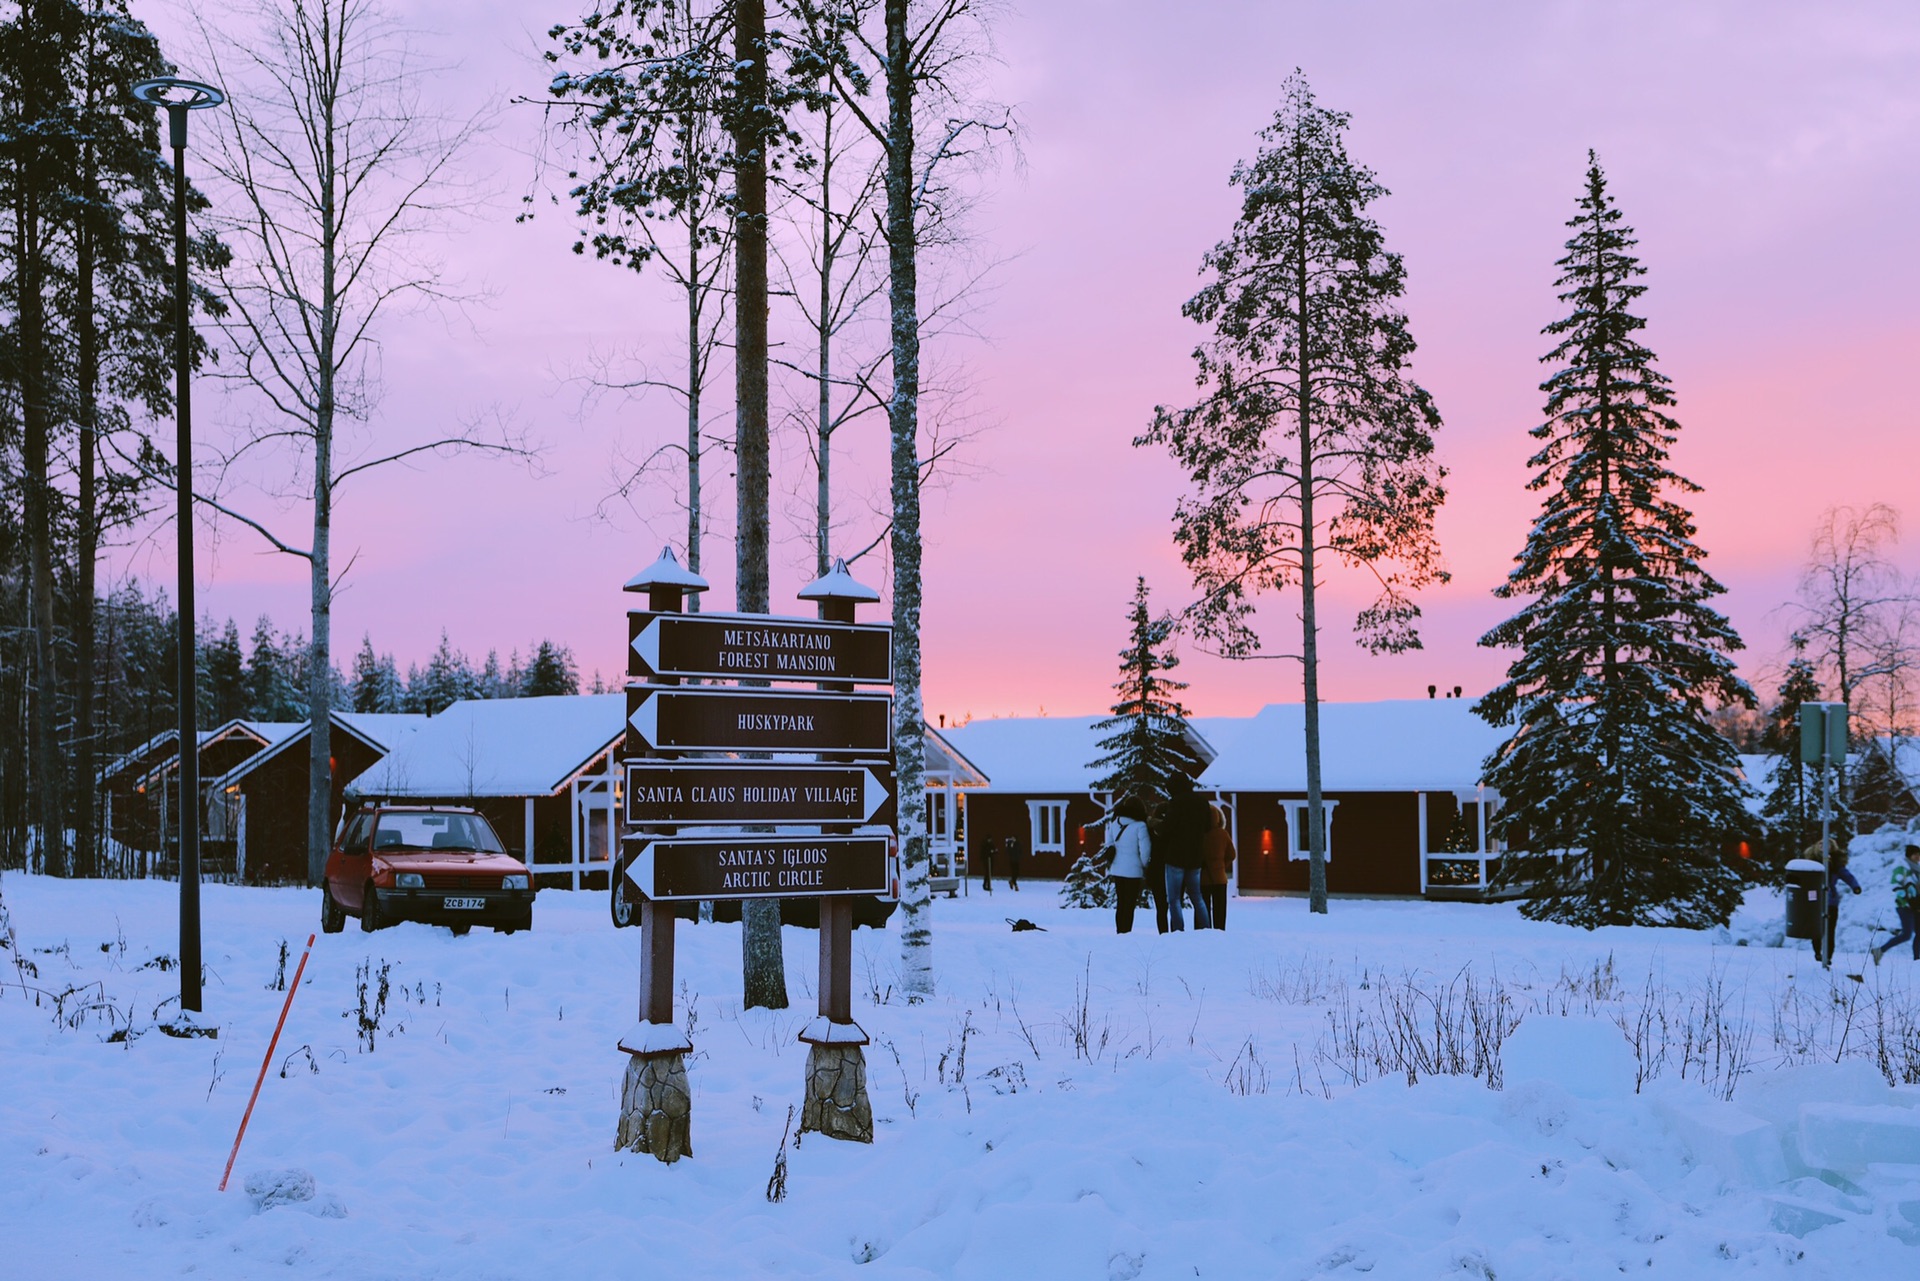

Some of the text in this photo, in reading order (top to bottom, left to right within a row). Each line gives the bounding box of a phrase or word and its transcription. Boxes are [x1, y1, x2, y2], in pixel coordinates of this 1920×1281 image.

[724, 629, 831, 650] METSÄKARTANO
[719, 651, 835, 672] FOREST MANSION
[738, 714, 814, 731] HUSKYPARK
[637, 786, 858, 806] SANTA CLAUS HOLIDAY VILLAGE
[718, 848, 827, 868] SANTA'S IGLOOS
[722, 869, 823, 888] ARCTIC CIRCLE
